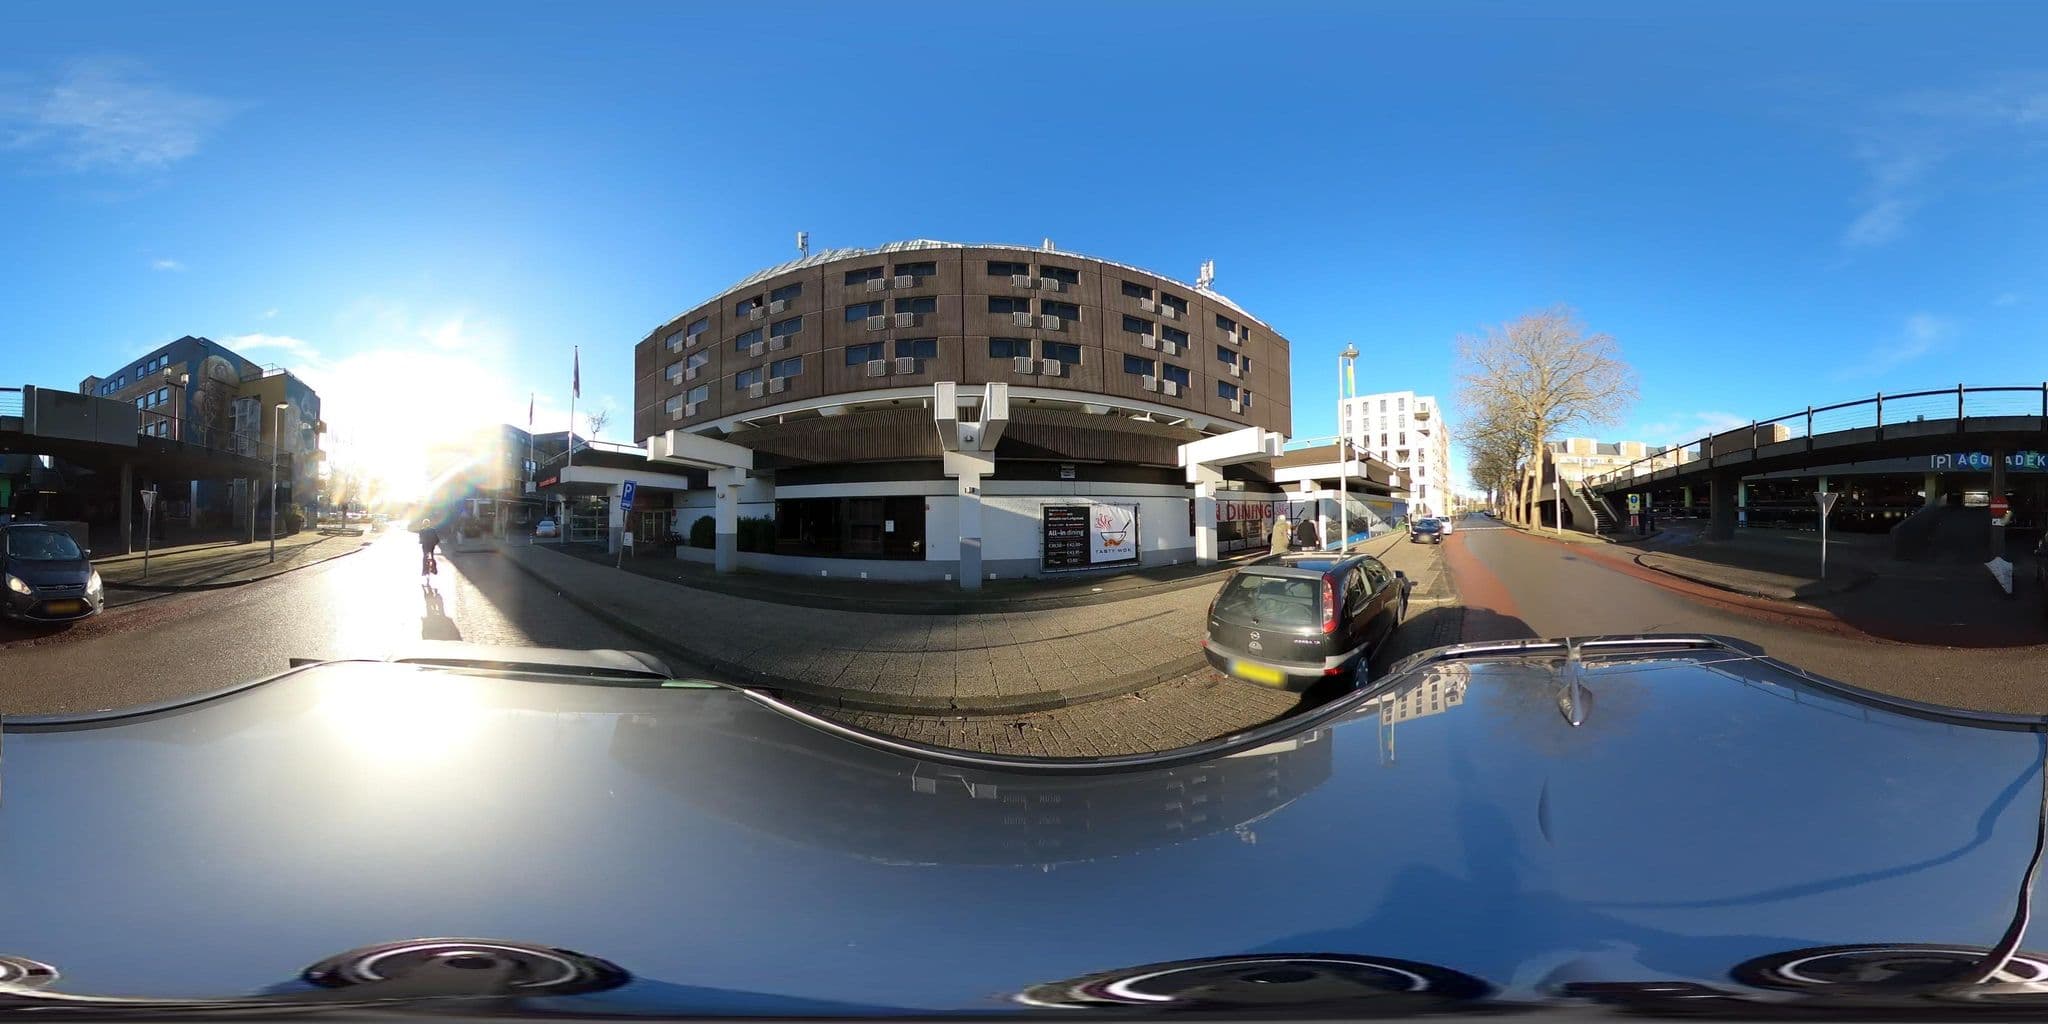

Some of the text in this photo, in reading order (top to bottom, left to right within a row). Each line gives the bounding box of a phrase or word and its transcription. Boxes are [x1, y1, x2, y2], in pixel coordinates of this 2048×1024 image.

[1958, 454, 2046, 466] AGOADEK
[624, 484, 632, 497] P
[1227, 504, 1272, 520] DINING
